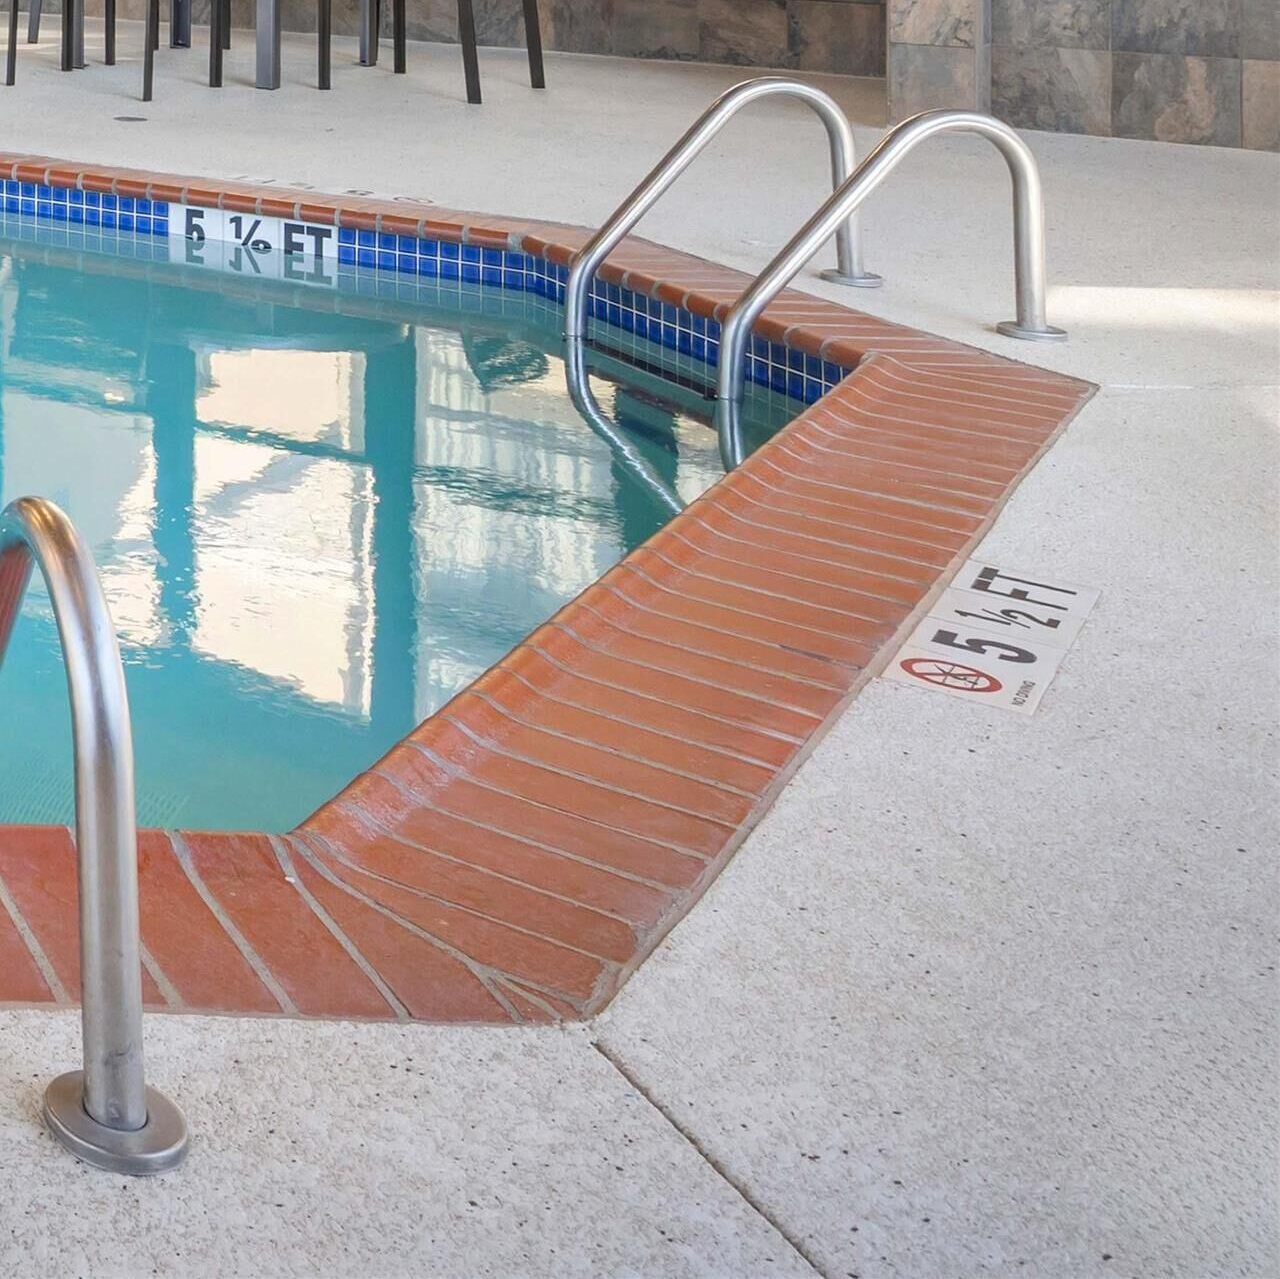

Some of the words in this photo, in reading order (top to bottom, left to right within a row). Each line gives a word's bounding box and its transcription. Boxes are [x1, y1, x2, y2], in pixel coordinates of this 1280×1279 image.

[283, 221, 333, 258] FT
[970, 566, 1077, 612] FT
[930, 628, 1038, 663] 5
